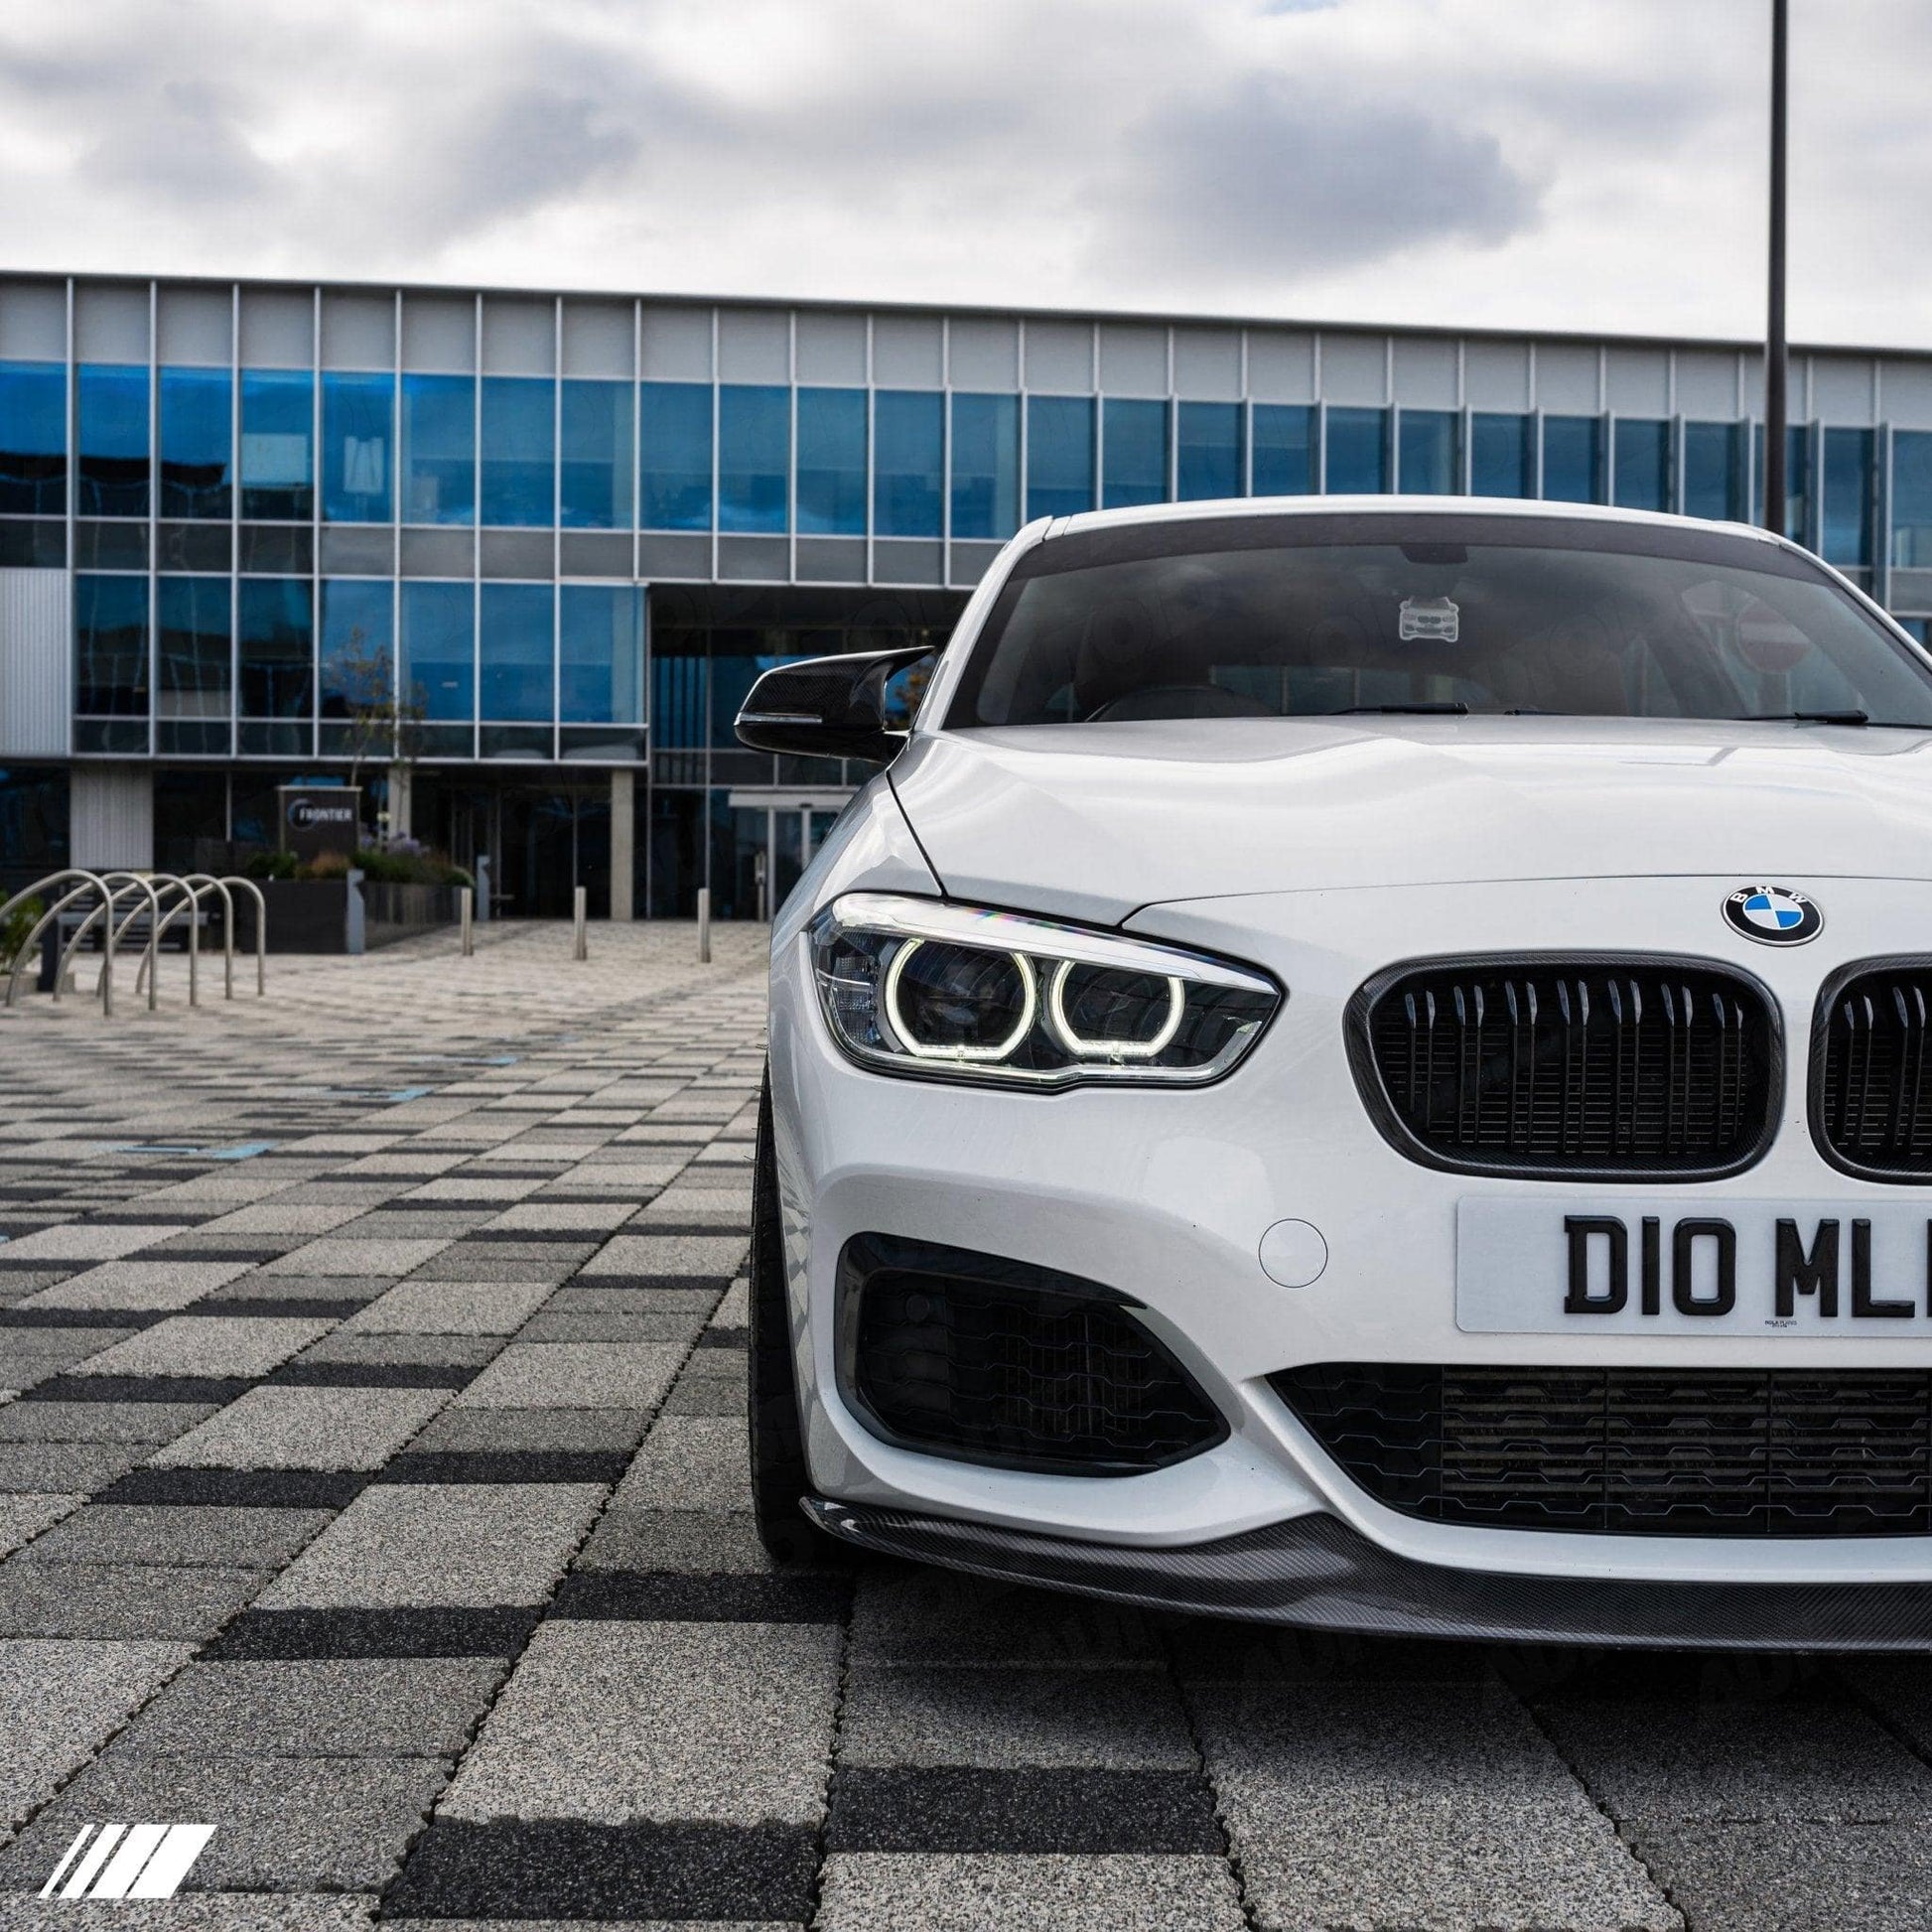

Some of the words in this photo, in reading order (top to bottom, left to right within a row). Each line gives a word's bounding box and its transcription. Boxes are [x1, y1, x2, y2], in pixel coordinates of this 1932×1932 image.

[299, 807, 352, 821] FRONTIER
[1729, 886, 1810, 903] BMW
[1775, 1218, 1932, 1317] ML
